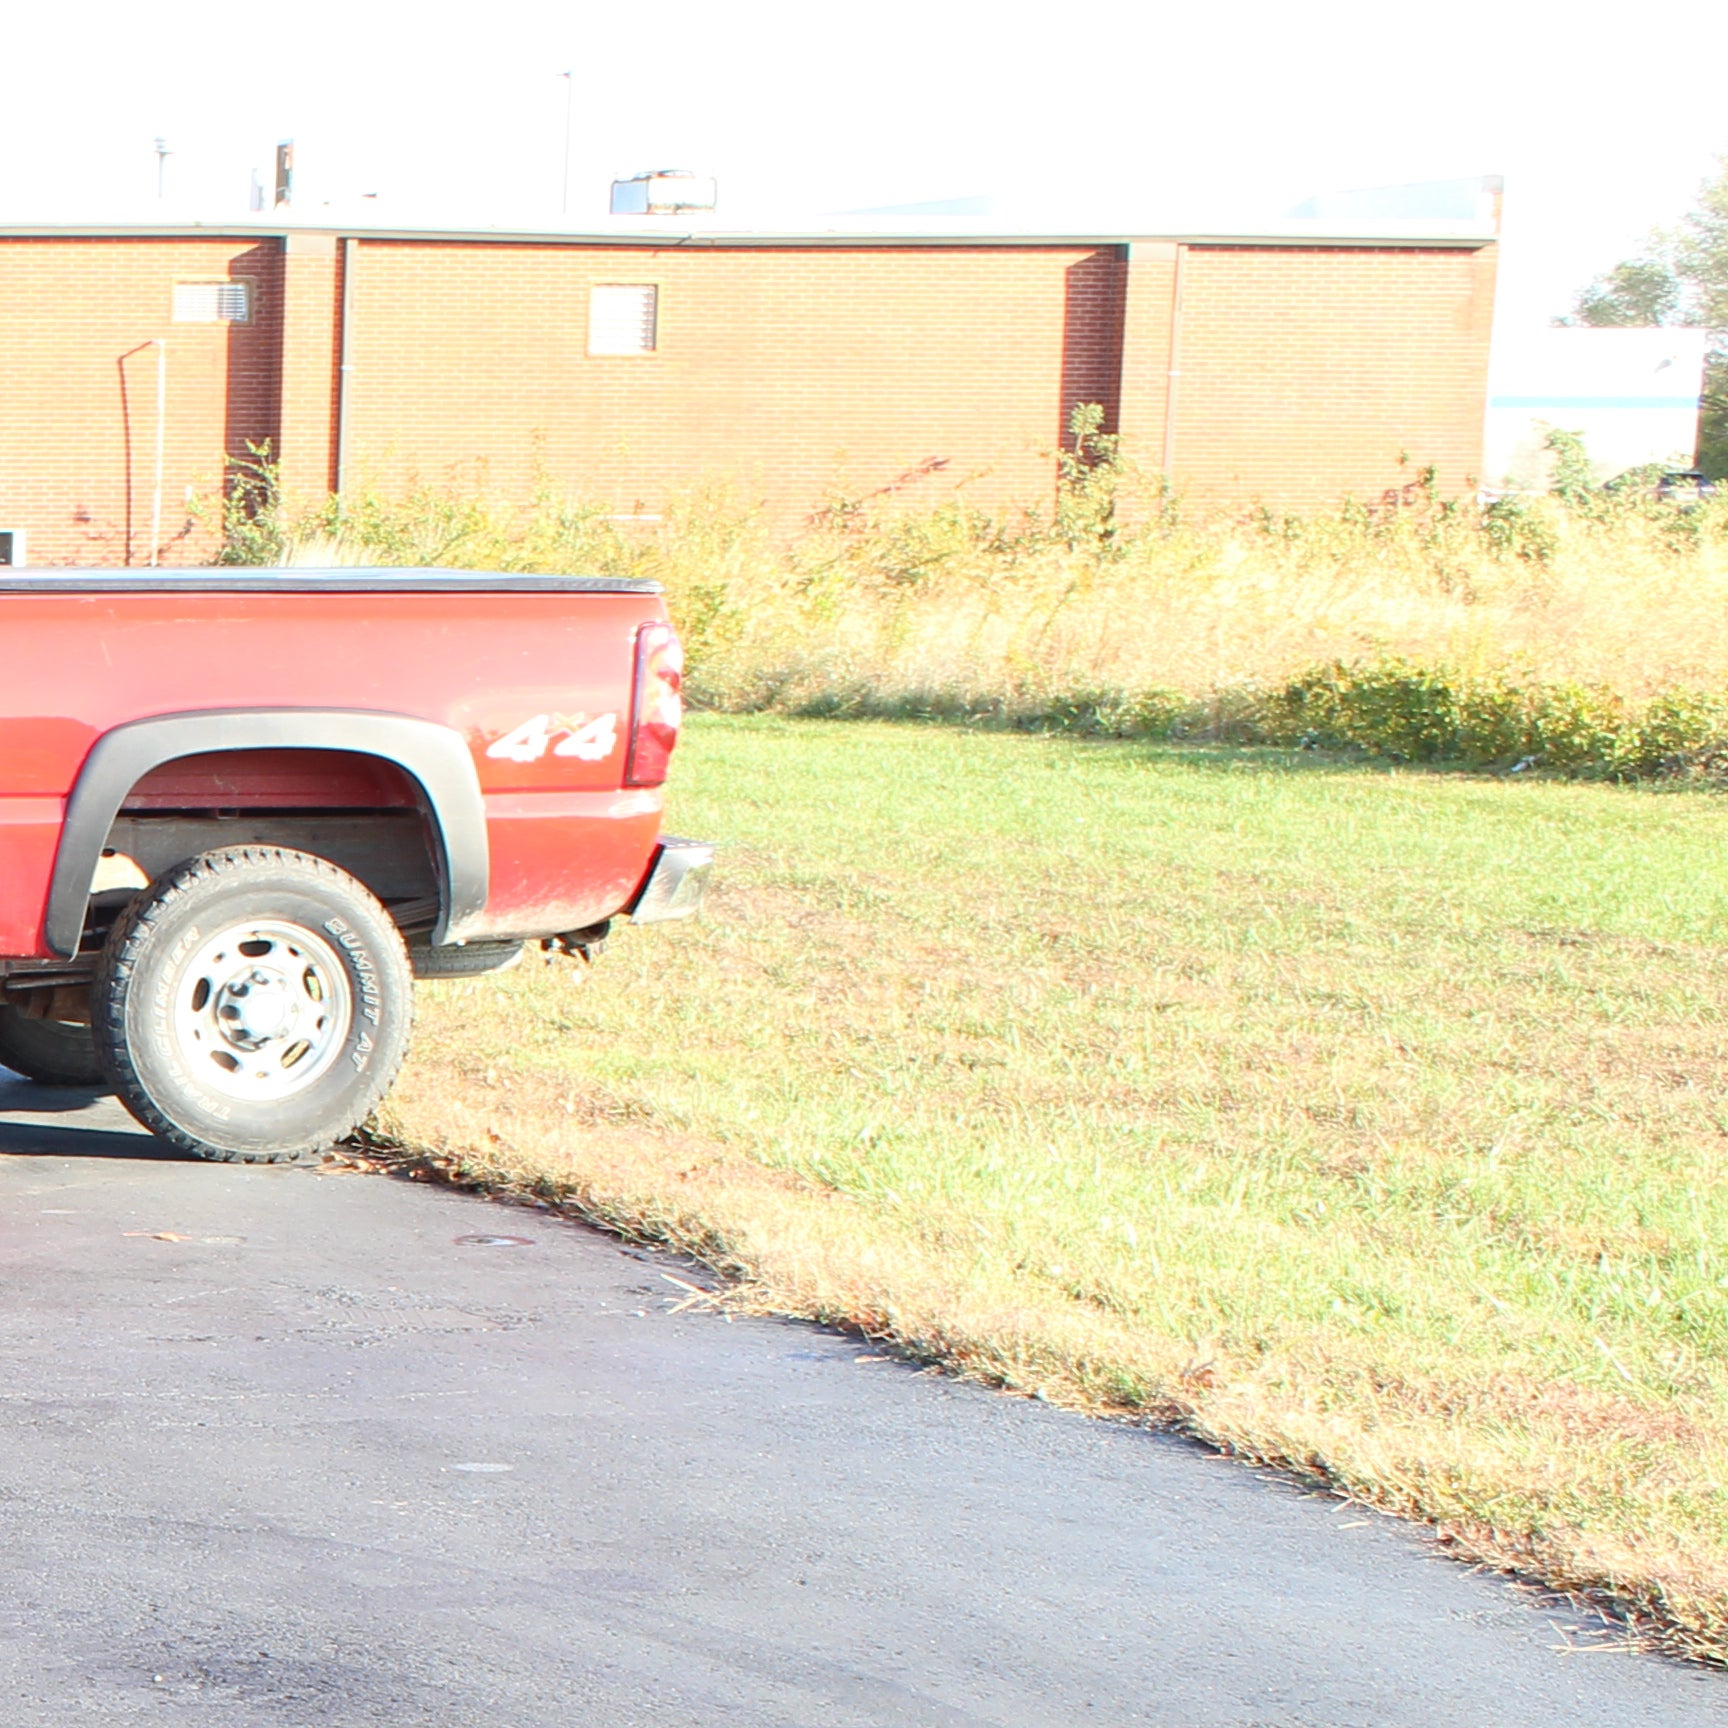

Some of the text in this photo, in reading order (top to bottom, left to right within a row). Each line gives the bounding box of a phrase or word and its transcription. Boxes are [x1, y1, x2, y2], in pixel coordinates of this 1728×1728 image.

[323, 918, 380, 1073] SUMMIT AT
[168, 1060, 232, 1121] TRAIL
